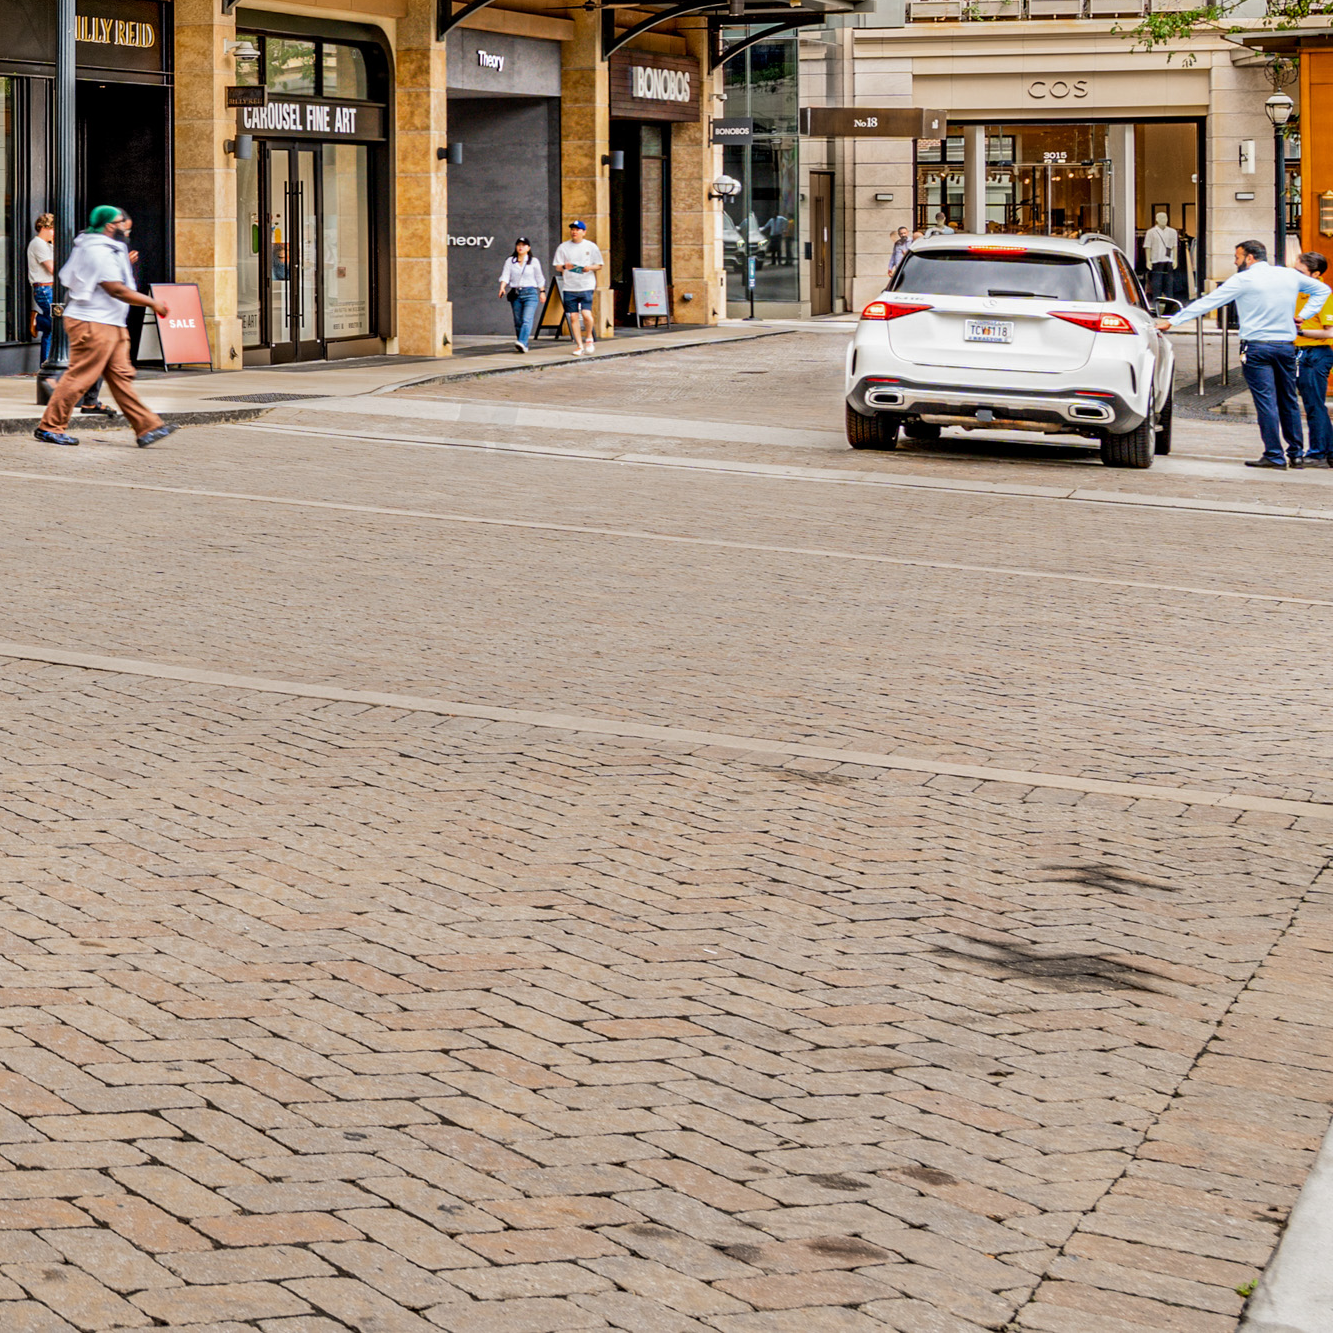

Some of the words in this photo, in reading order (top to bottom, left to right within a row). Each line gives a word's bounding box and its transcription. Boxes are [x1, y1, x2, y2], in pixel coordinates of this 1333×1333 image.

[74, 15, 113, 44] ILLY
[114, 20, 155, 48] REID
[477, 50, 504, 72] Theory
[632, 66, 690, 103] BONOBOS
[1027, 80, 1088, 99] COS
[243, 103, 303, 131] CAROUSEL
[306, 105, 331, 132] FINE
[334, 107, 357, 134] ART
[715, 127, 750, 136] BONOBOS
[1043, 151, 1068, 160] 3015
[446, 234, 494, 249] heory
[169, 318, 196, 329] SALE
